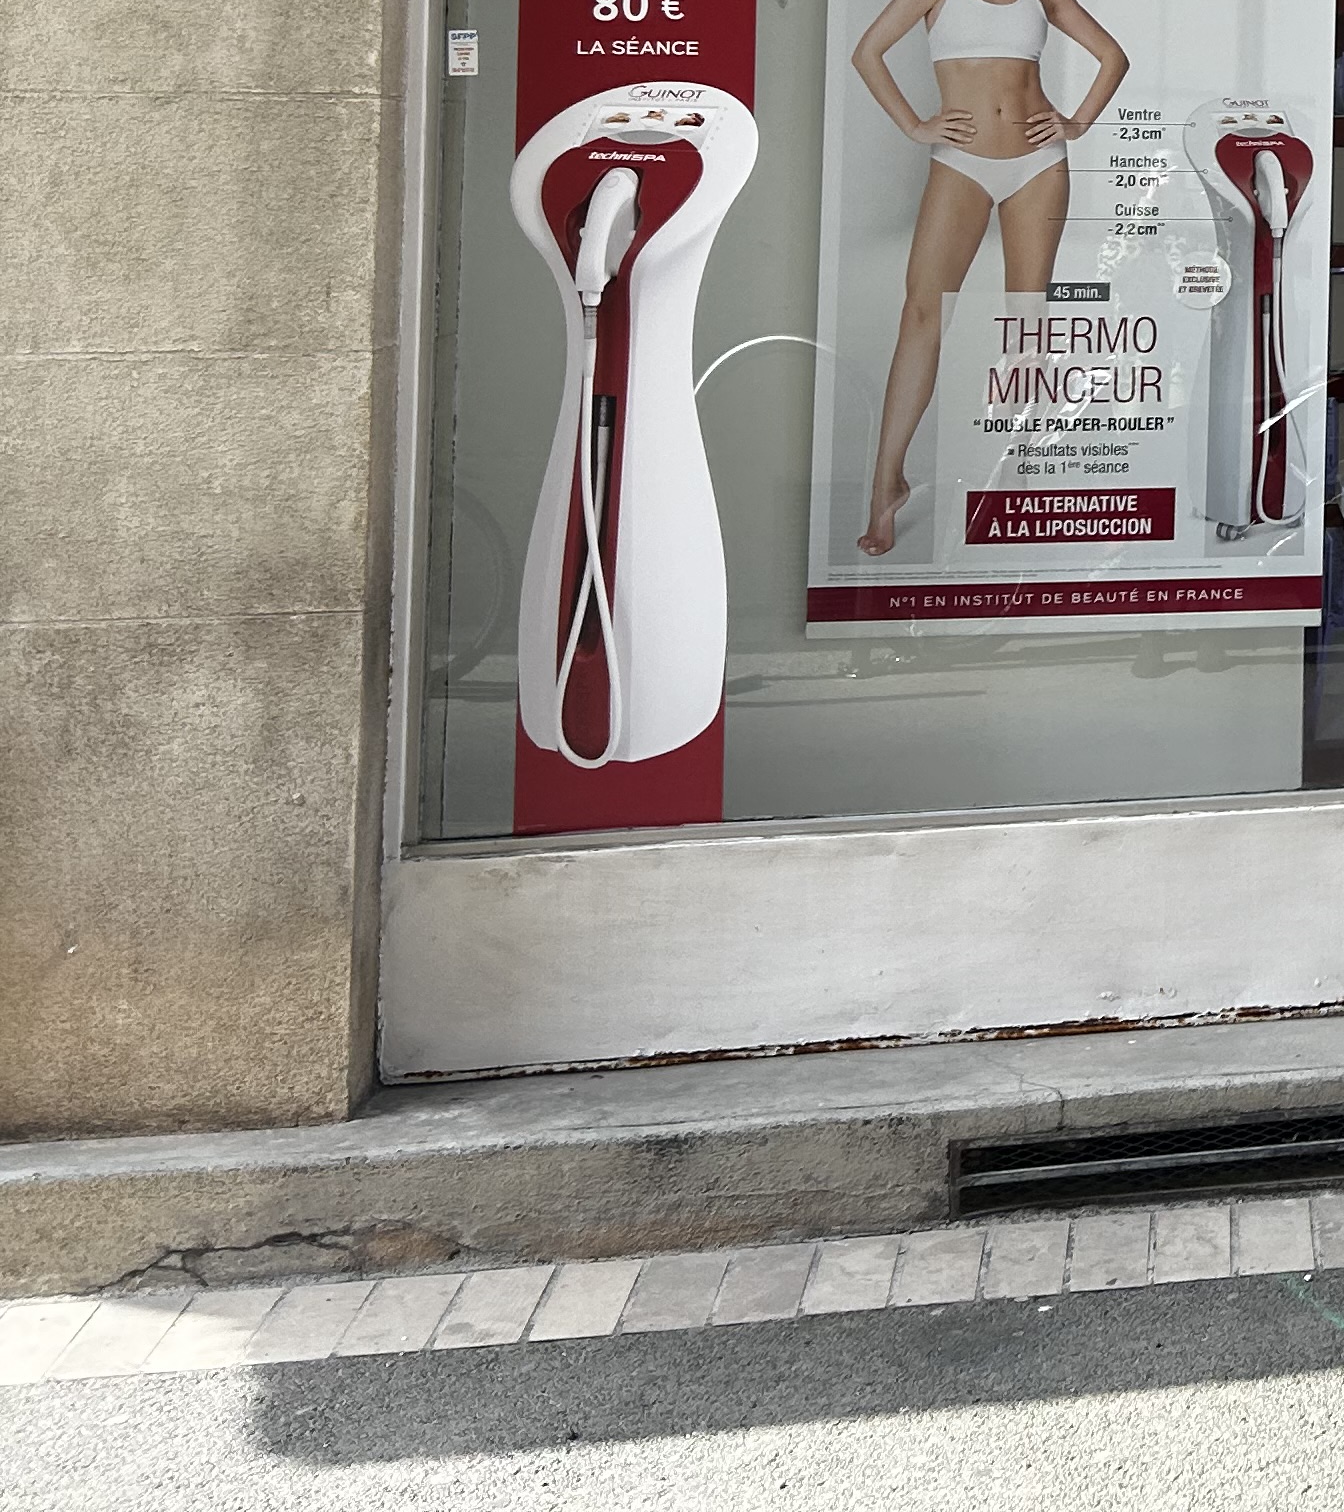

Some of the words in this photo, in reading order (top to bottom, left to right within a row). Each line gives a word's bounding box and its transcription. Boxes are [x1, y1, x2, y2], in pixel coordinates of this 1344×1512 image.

[576, 40, 605, 55] LA
[612, 36, 699, 56] SÉANCE
[627, 84, 706, 99] GUINOT
[1118, 107, 1162, 121] Ventre
[1109, 155, 1168, 168] Hanches
[1115, 203, 1160, 217] Cuisse
[1053, 285, 1070, 299] 45
[1073, 285, 1103, 299] min.
[993, 316, 1158, 355] THERMO
[987, 366, 1163, 405] MINCEUR
[1017, 443, 1077, 458] Résultats
[1017, 460, 1040, 475] dès
[1044, 460, 1056, 475] la
[1083, 460, 1130, 474] séance
[1004, 494, 1139, 515] L'ALTERNATIVE
[988, 517, 1002, 538] À
[1007, 520, 1030, 538] LA
[1035, 517, 1153, 537] LIPOSUCCION
[923, 594, 947, 608] EN
[953, 592, 1035, 607] INSTITUT
[1041, 592, 1064, 605] DE
[1070, 587, 1140, 604] BEAUTÉ
[1146, 590, 1169, 602] EN
[1175, 588, 1245, 601] FRANCE
